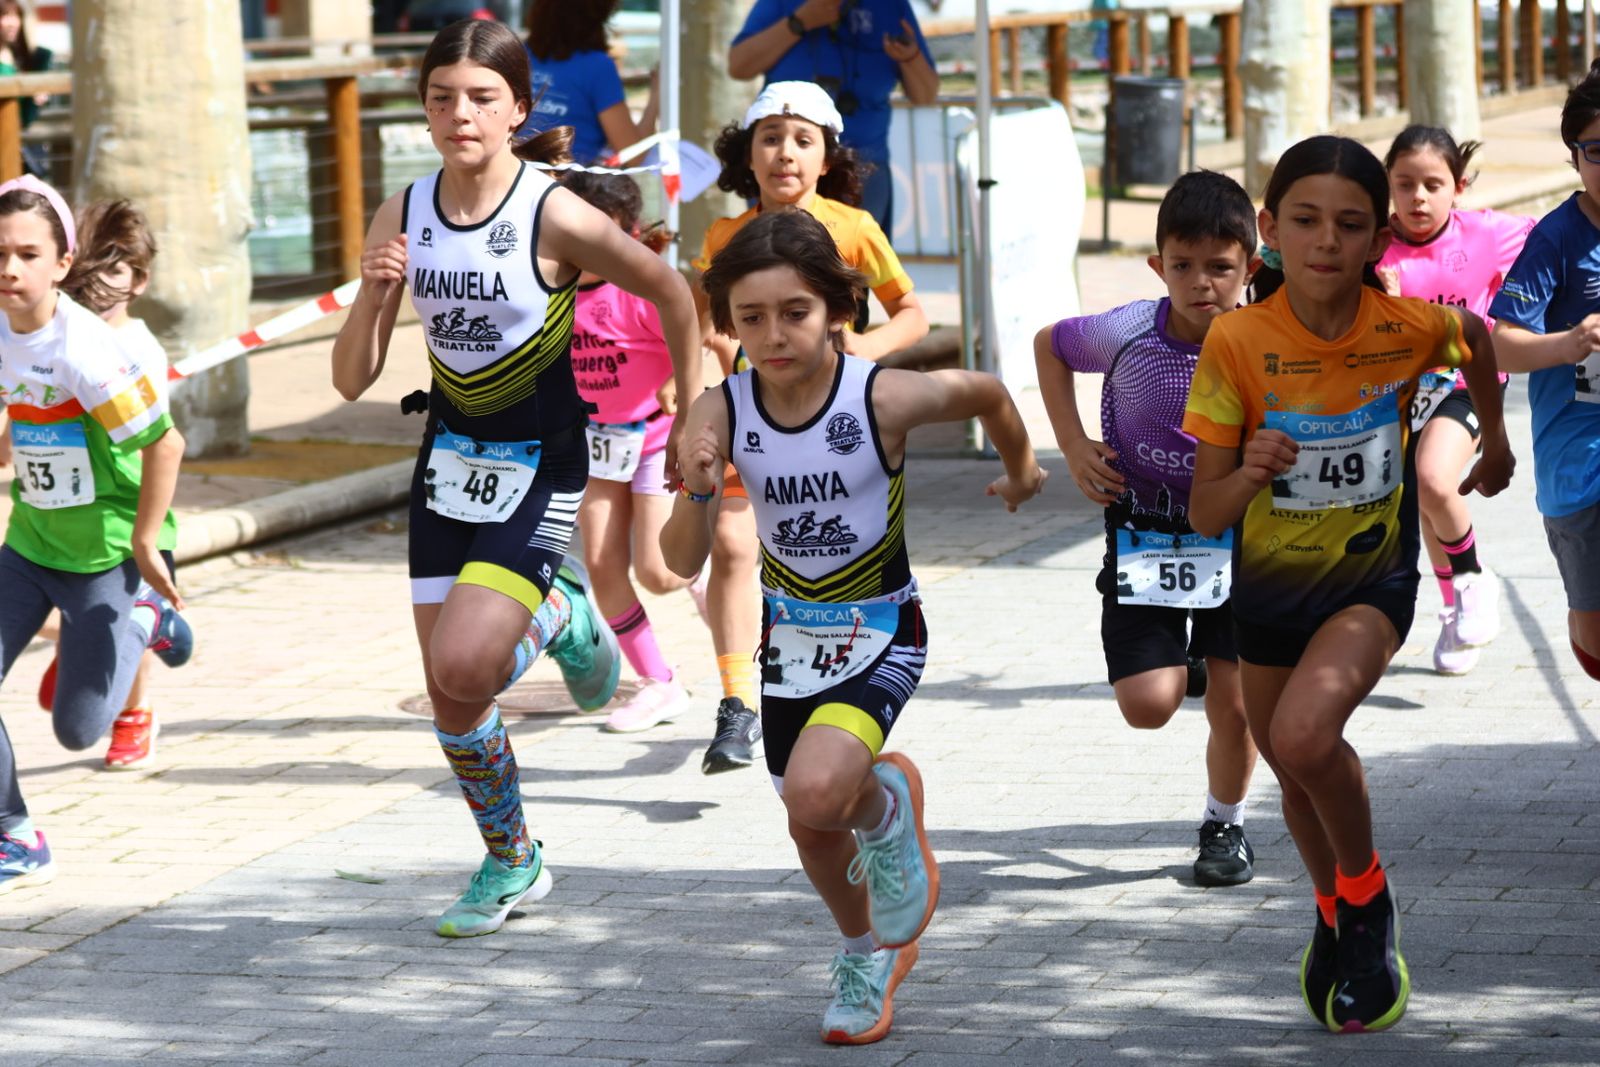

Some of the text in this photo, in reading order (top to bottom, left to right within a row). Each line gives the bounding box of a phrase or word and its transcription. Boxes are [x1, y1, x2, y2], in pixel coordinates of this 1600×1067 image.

[414, 268, 509, 301] MANUELA
[433, 338, 496, 352] TRIATLÓN
[591, 436, 611, 463] 51
[829, 436, 861, 447] TRIATLÓN
[1338, 434, 1378, 450] SALAMANCA
[27, 461, 55, 491] 53
[1318, 453, 1365, 489] 49
[462, 470, 499, 505] 48
[765, 471, 850, 505] AMAYA
[1269, 510, 1323, 522] ALTAFIT
[777, 546, 851, 558] TRIATLÓN
[1159, 561, 1196, 592] 56
[831, 632, 872, 640] SALAMANCA
[811, 644, 853, 678] 45
